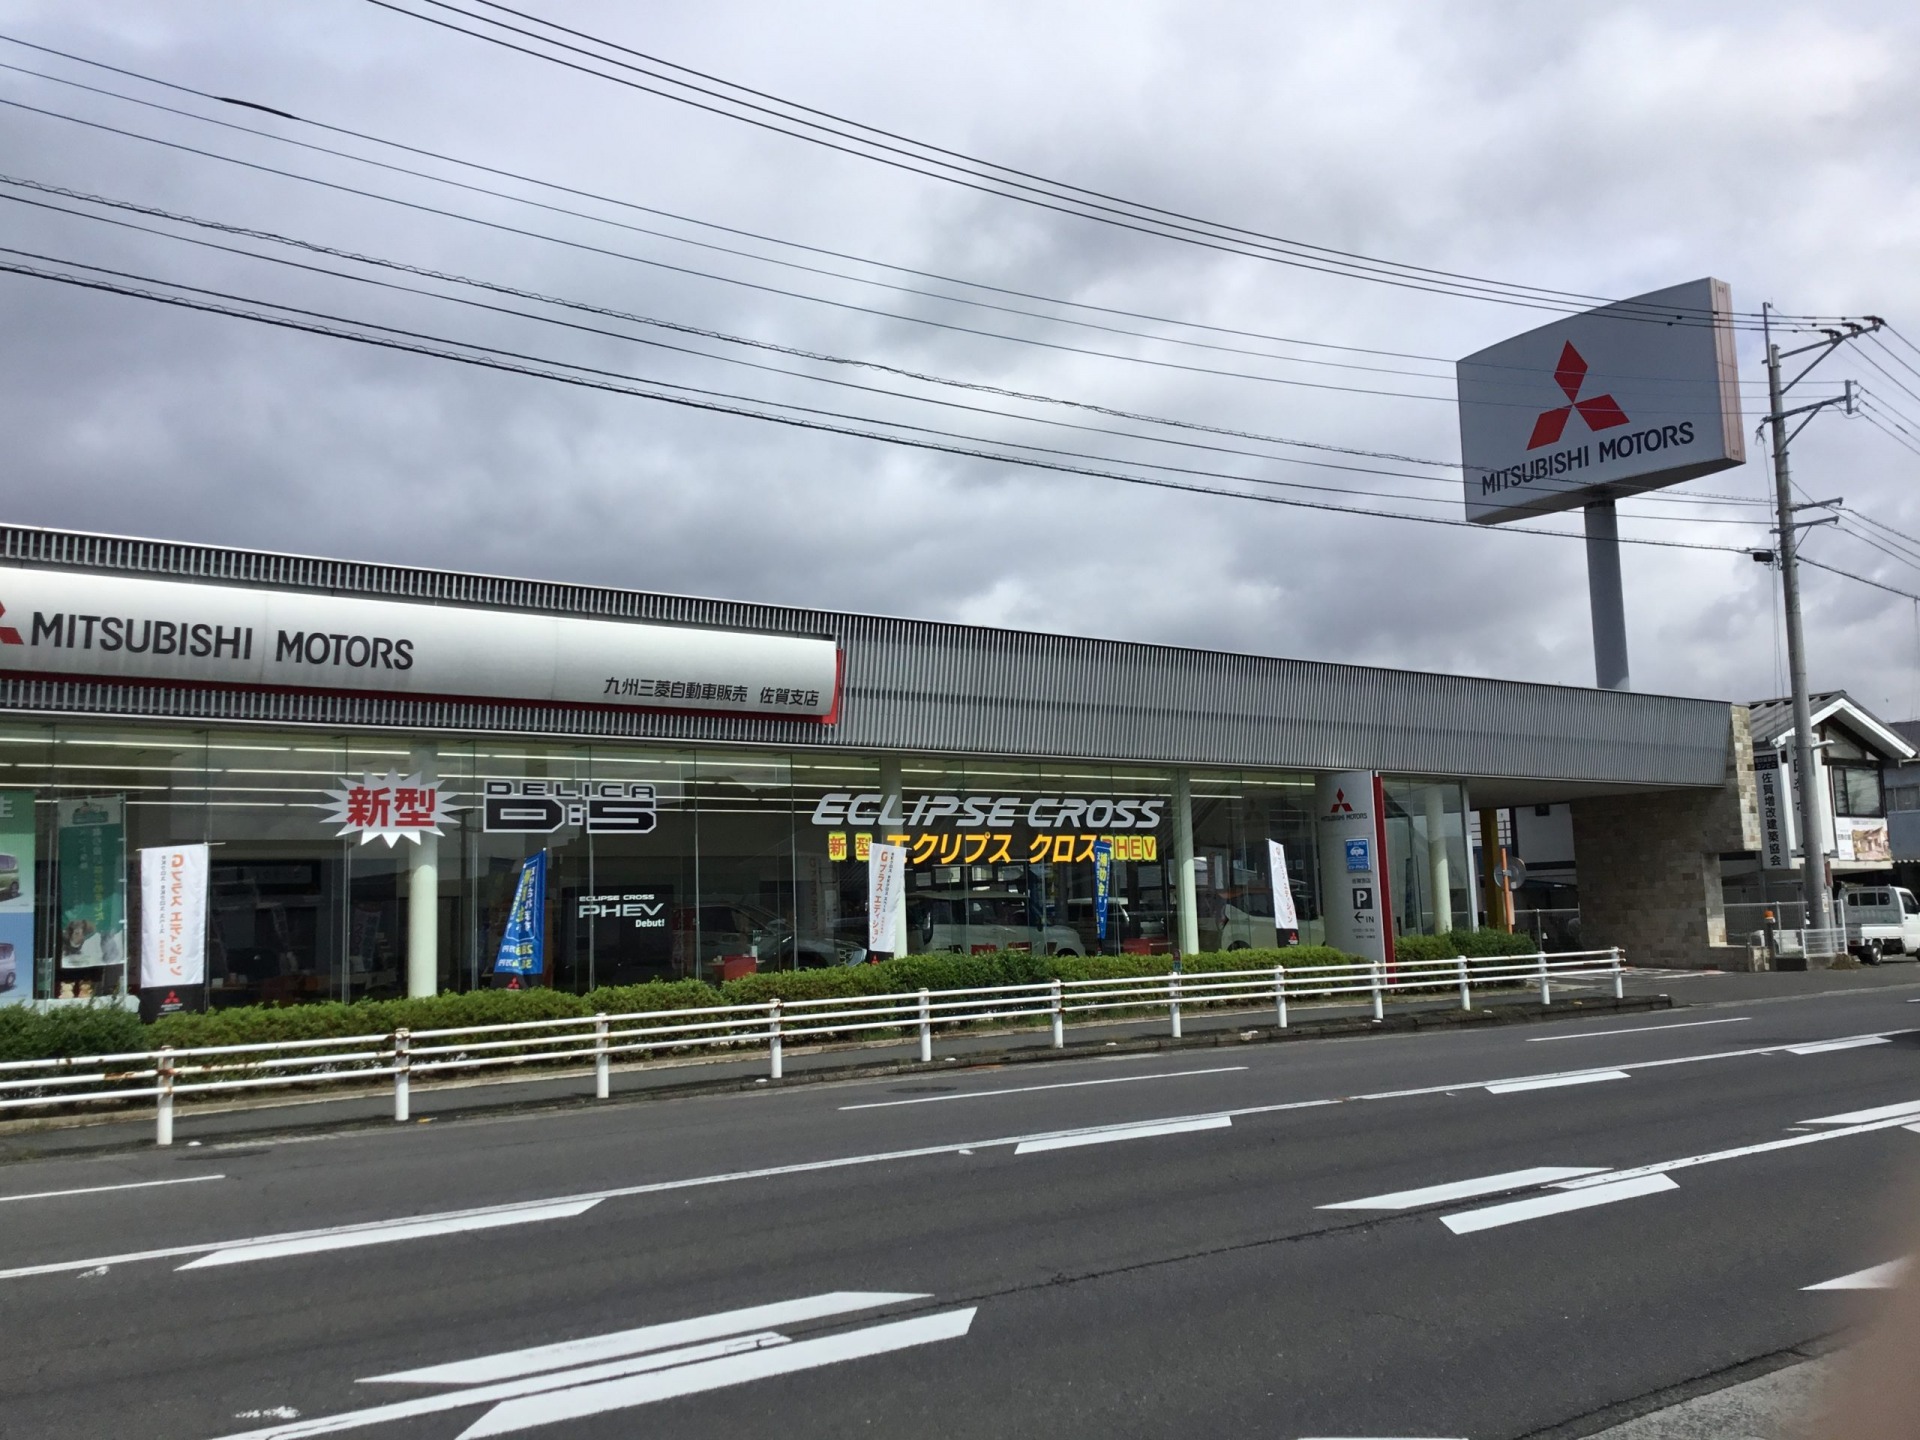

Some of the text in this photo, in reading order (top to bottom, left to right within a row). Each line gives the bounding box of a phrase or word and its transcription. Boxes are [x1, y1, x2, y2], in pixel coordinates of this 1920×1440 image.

[1482, 421, 1695, 496] MITSUBISHI MOTORS
[31, 611, 414, 670] MITSUBISHI MOTORS
[604, 677, 819, 707] 九州三菱自動車販売 佐賀支店
[485, 780, 657, 799] DELICA
[346, 786, 436, 828] 新型
[483, 797, 657, 833] D:5
[812, 792, 1165, 828] ECLIPSE CROSS
[1763, 773, 1782, 866] 佐賀増改建築協会
[1029, 833, 1097, 863] クロス
[578, 902, 664, 918] PHEV
[1356, 890, 1368, 908] P
[635, 918, 665, 928] Debut!
[1365, 915, 1375, 924] IN
